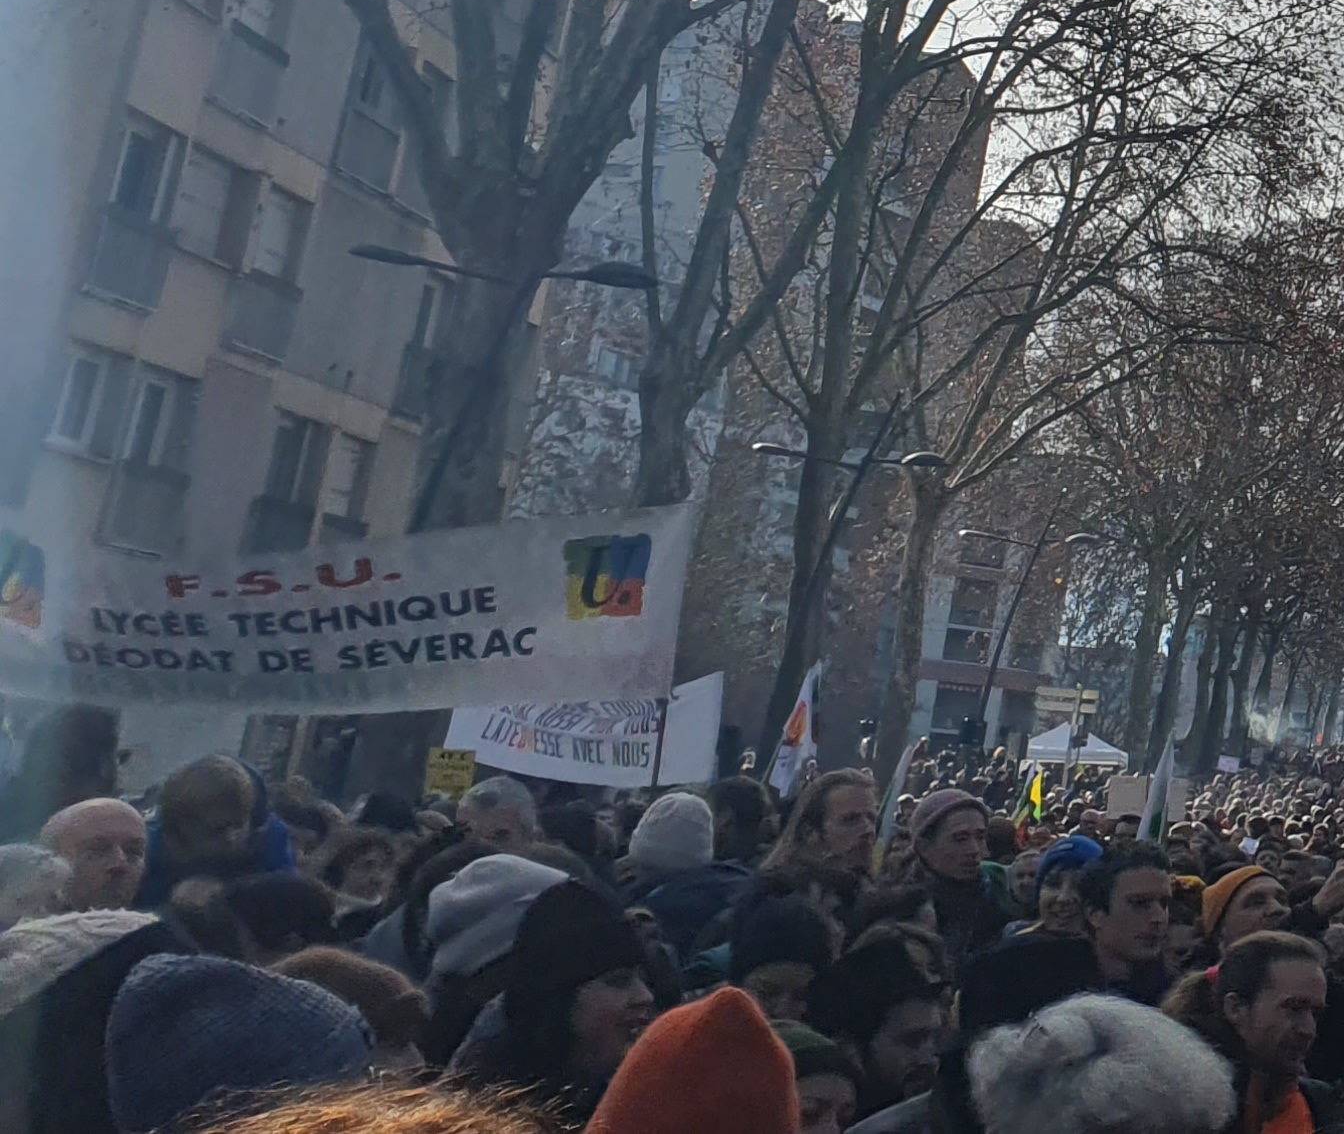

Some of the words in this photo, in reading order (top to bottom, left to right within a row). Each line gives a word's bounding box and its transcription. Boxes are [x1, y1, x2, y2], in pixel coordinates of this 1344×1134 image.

[164, 558, 401, 598] F.S.U.
[228, 586, 498, 638] TECHNIQUE
[257, 648, 314, 673] DE
[572, 736, 605, 766] AVEC
[612, 740, 650, 768] NOUS
